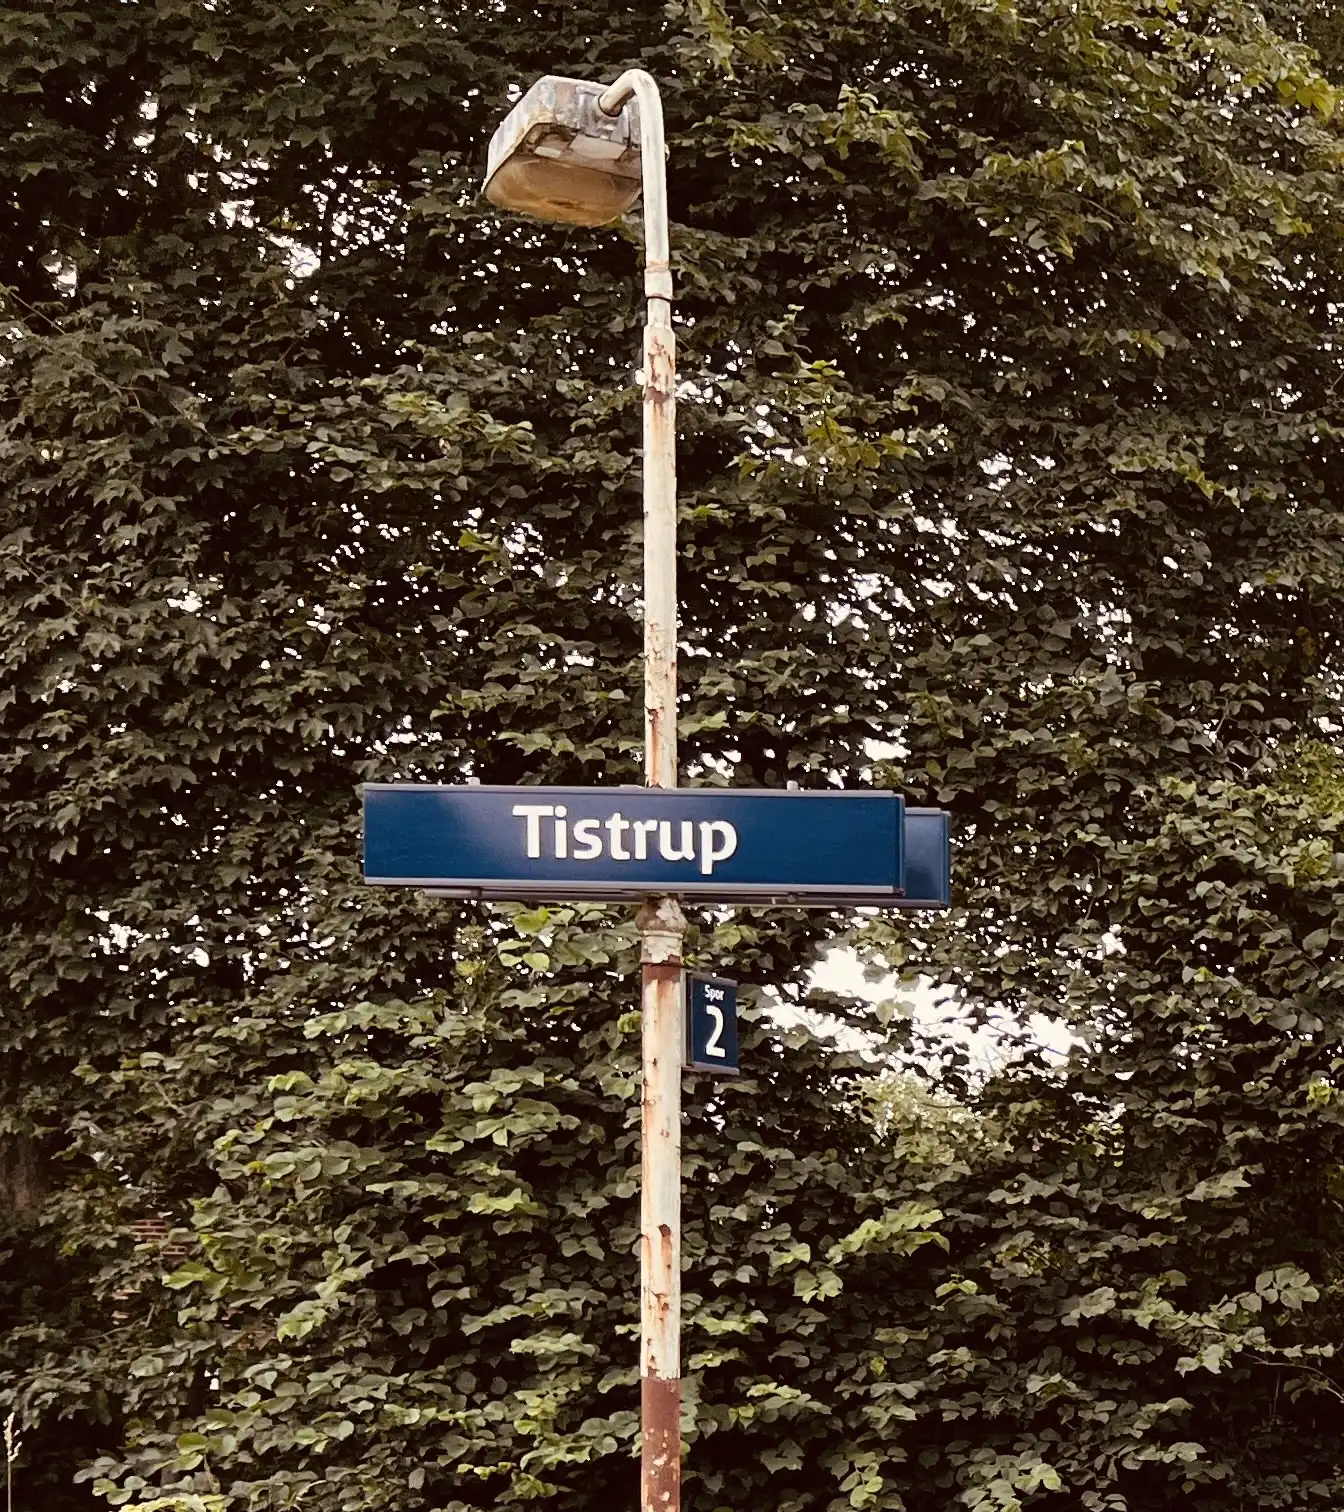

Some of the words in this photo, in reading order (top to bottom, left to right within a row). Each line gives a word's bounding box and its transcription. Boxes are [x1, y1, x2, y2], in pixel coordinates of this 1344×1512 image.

[511, 804, 738, 875] Tistrup
[704, 984, 724, 1001] Spor
[705, 1005, 725, 1057] 2
